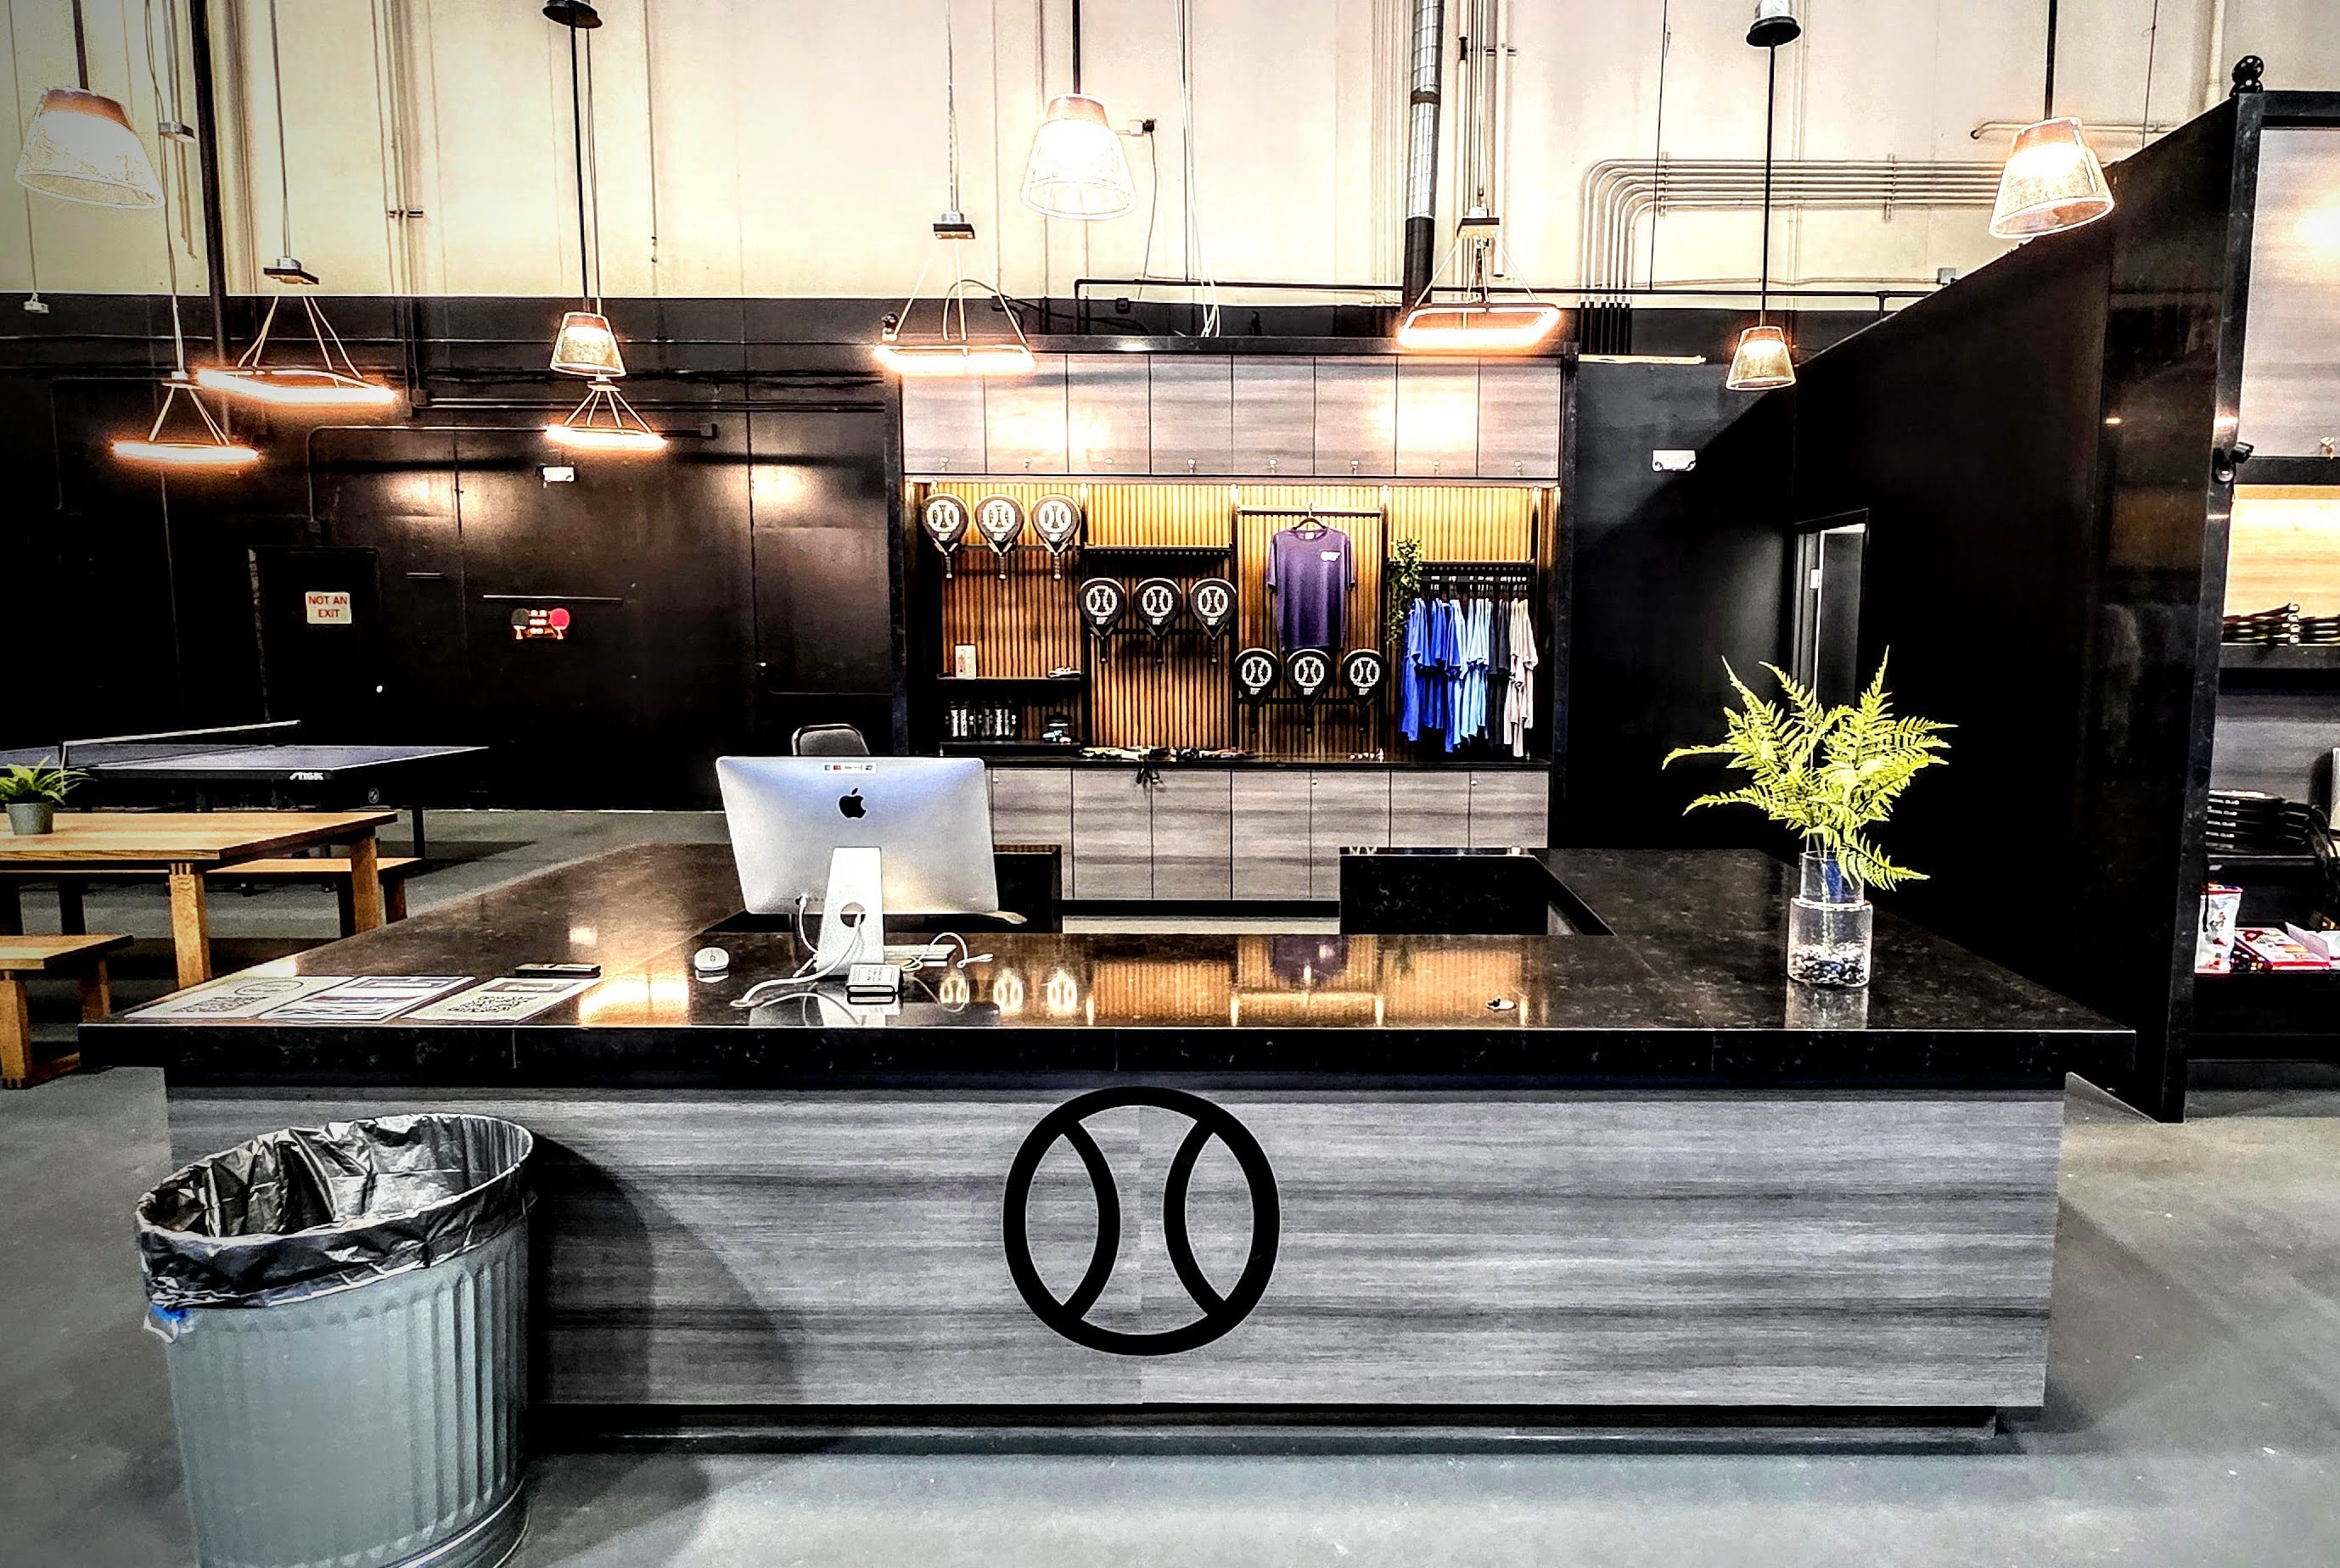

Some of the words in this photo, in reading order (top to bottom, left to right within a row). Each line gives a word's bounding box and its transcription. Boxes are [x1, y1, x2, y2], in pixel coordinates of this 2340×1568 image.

[308, 596, 329, 605] NOT
[333, 596, 348, 605] AN
[318, 608, 339, 618] EXIT
